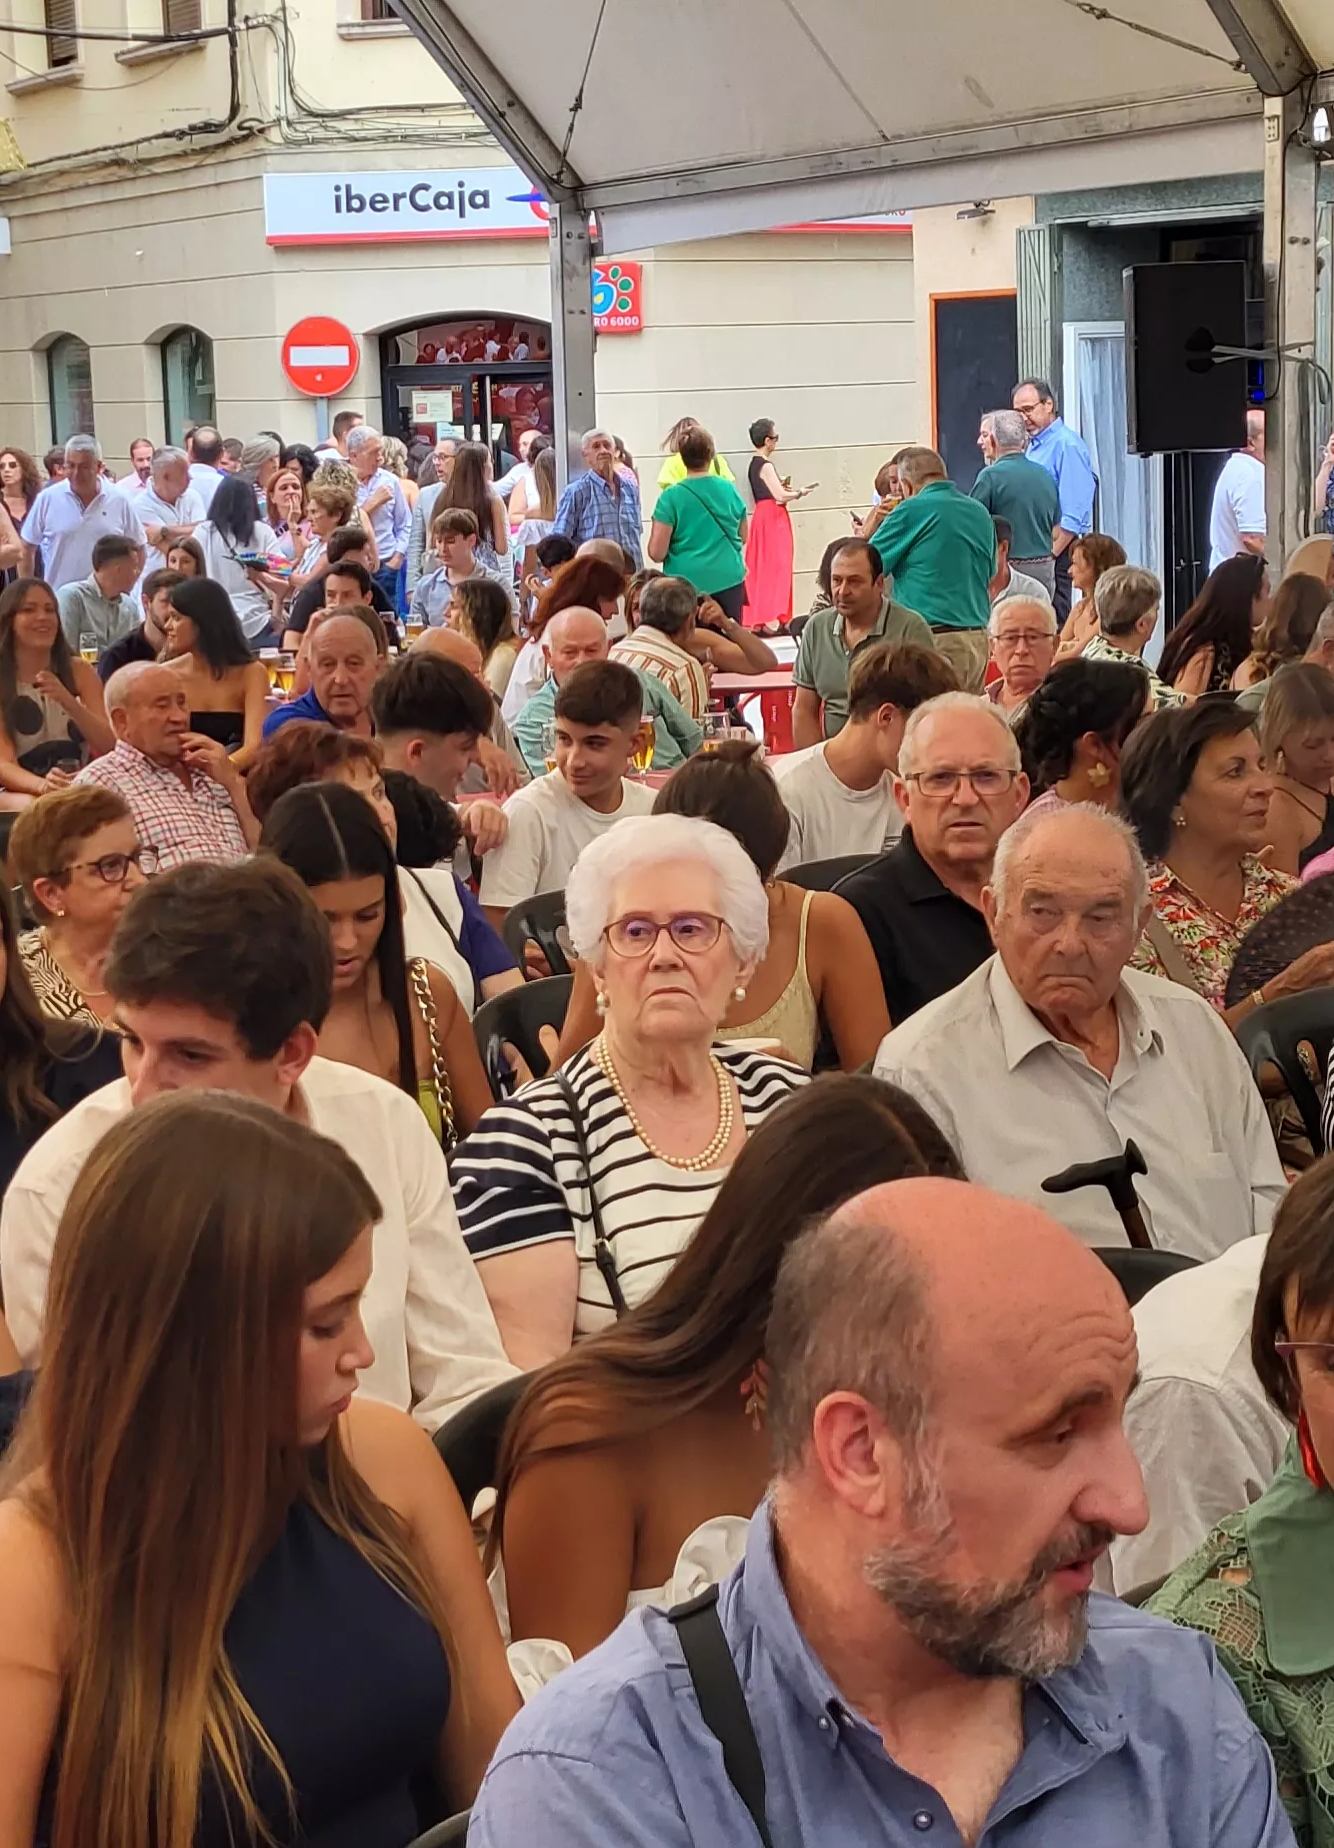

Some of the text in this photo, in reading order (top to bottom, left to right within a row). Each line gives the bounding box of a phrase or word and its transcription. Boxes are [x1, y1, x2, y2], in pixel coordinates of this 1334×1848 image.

[334, 182, 490, 219] iberCaja
[593, 316, 639, 327] RO 6000
